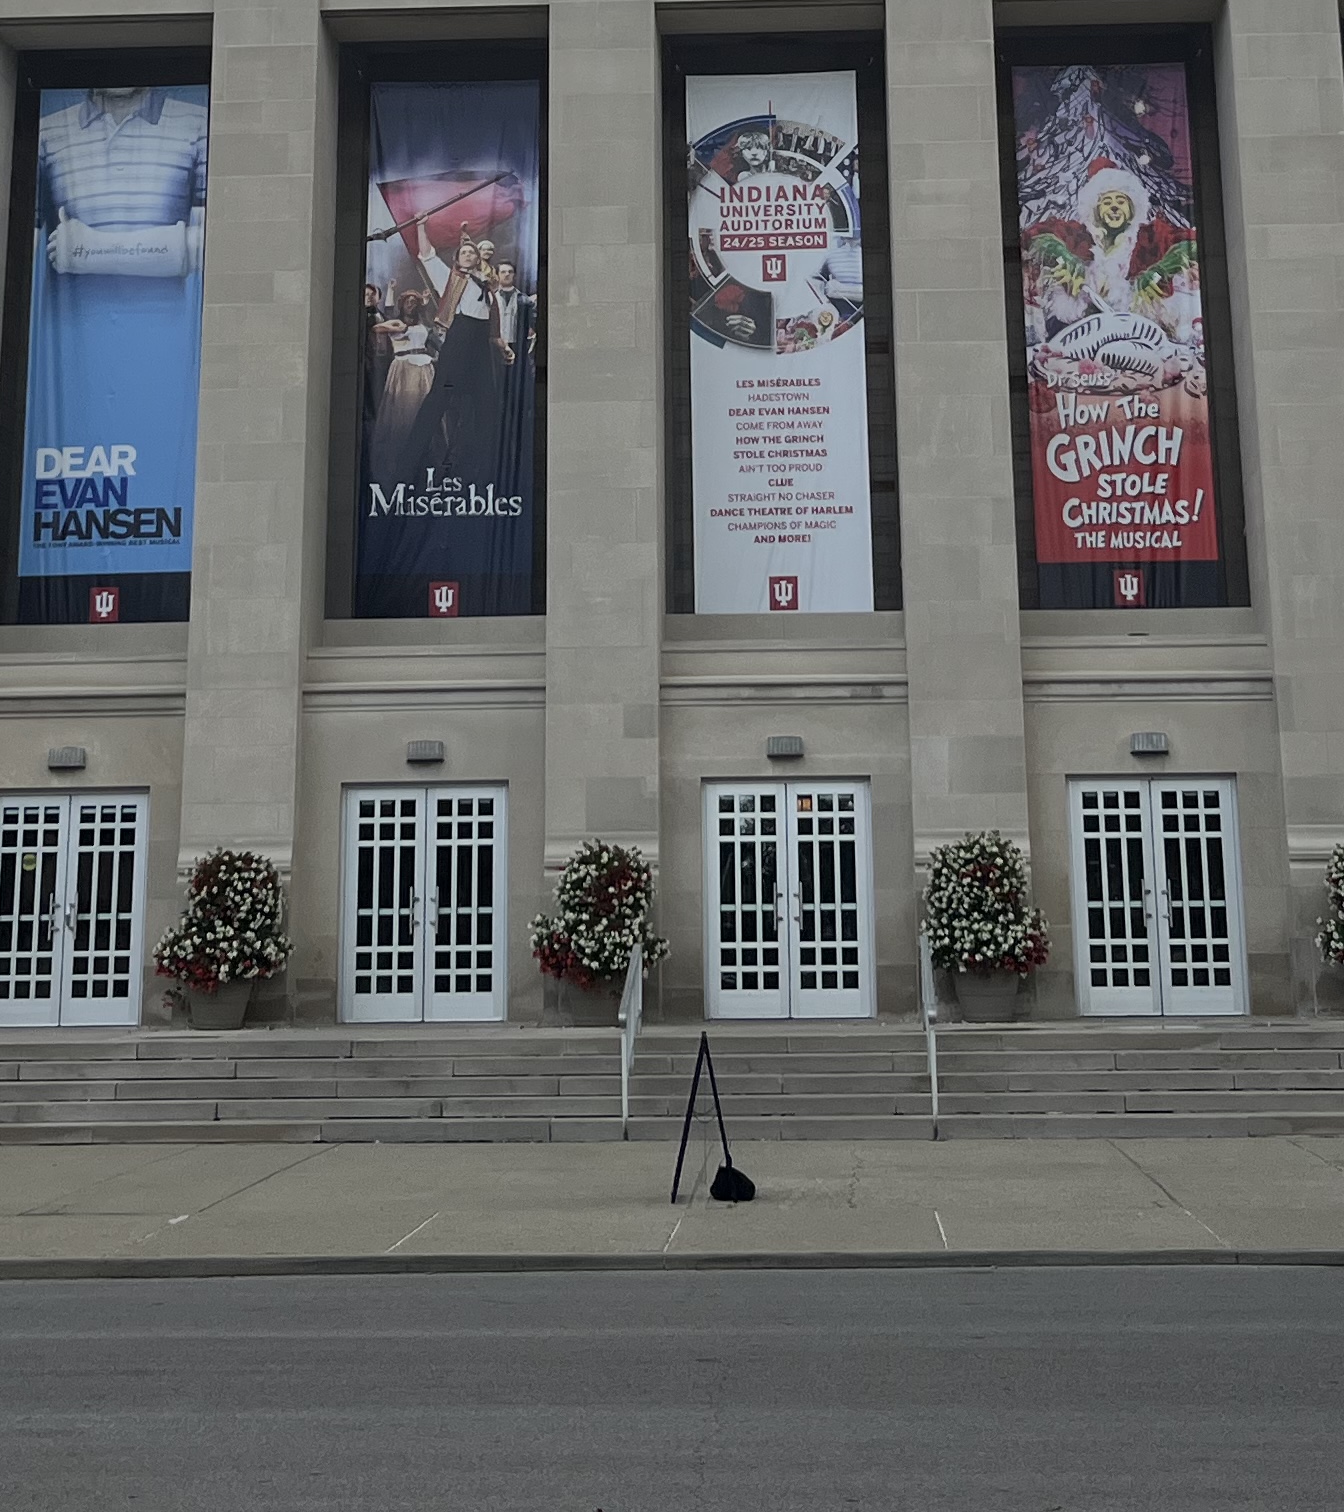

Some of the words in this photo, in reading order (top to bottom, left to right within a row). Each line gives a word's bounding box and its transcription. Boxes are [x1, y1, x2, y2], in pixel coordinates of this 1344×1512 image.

[720, 184, 825, 203] INDIANA
[720, 203, 826, 218] UNIVERSITY
[720, 218, 827, 232] AUDITORIUM
[723, 236, 765, 248] 24/25
[768, 234, 824, 247] SEASON
[736, 380, 754, 388] LES
[757, 377, 821, 388] MISÉRABLES
[748, 392, 810, 402] HADESTOWN
[728, 408, 755, 417] DEAR
[758, 407, 785, 416] EVAN
[787, 406, 830, 415] HANSEN
[1055, 392, 1109, 429] How
[1115, 395, 1160, 420] The
[736, 422, 764, 431] COME
[767, 421, 794, 430] FROM
[797, 420, 823, 429] AWAY
[736, 436, 760, 445] HOW
[762, 436, 782, 444] THE
[784, 434, 824, 443] GRINCH
[733, 450, 765, 460] STOLE
[768, 448, 828, 458] CHRISTMAS
[1046, 424, 1184, 483] GRINCH
[35, 444, 137, 480] DEAR
[767, 464, 787, 472] TOO
[788, 463, 823, 472] PROUD
[425, 466, 463, 492] Les
[768, 478, 794, 487] CLUE
[1096, 472, 1168, 498] STOLE
[34, 476, 129, 510] EVAN
[368, 483, 523, 516] Misérables
[728, 493, 776, 502] STRAIGHT
[778, 492, 793, 501] NO
[796, 491, 835, 500] CHASER
[710, 508, 745, 517] DANCE
[748, 507, 793, 516] THEATRE
[796, 506, 808, 515] OF
[811, 506, 853, 514] HARLEM
[1062, 488, 1204, 528] CHRISTMAS!
[33, 506, 182, 542] HANSEN
[727, 522, 787, 532] CHAMPIONS
[790, 521, 802, 530] OF
[805, 520, 837, 529] MAGIC
[754, 535, 775, 544] AND
[778, 534, 811, 543] MORE!
[1074, 530, 1106, 549] THE
[1110, 529, 1182, 549] MUSICAL
